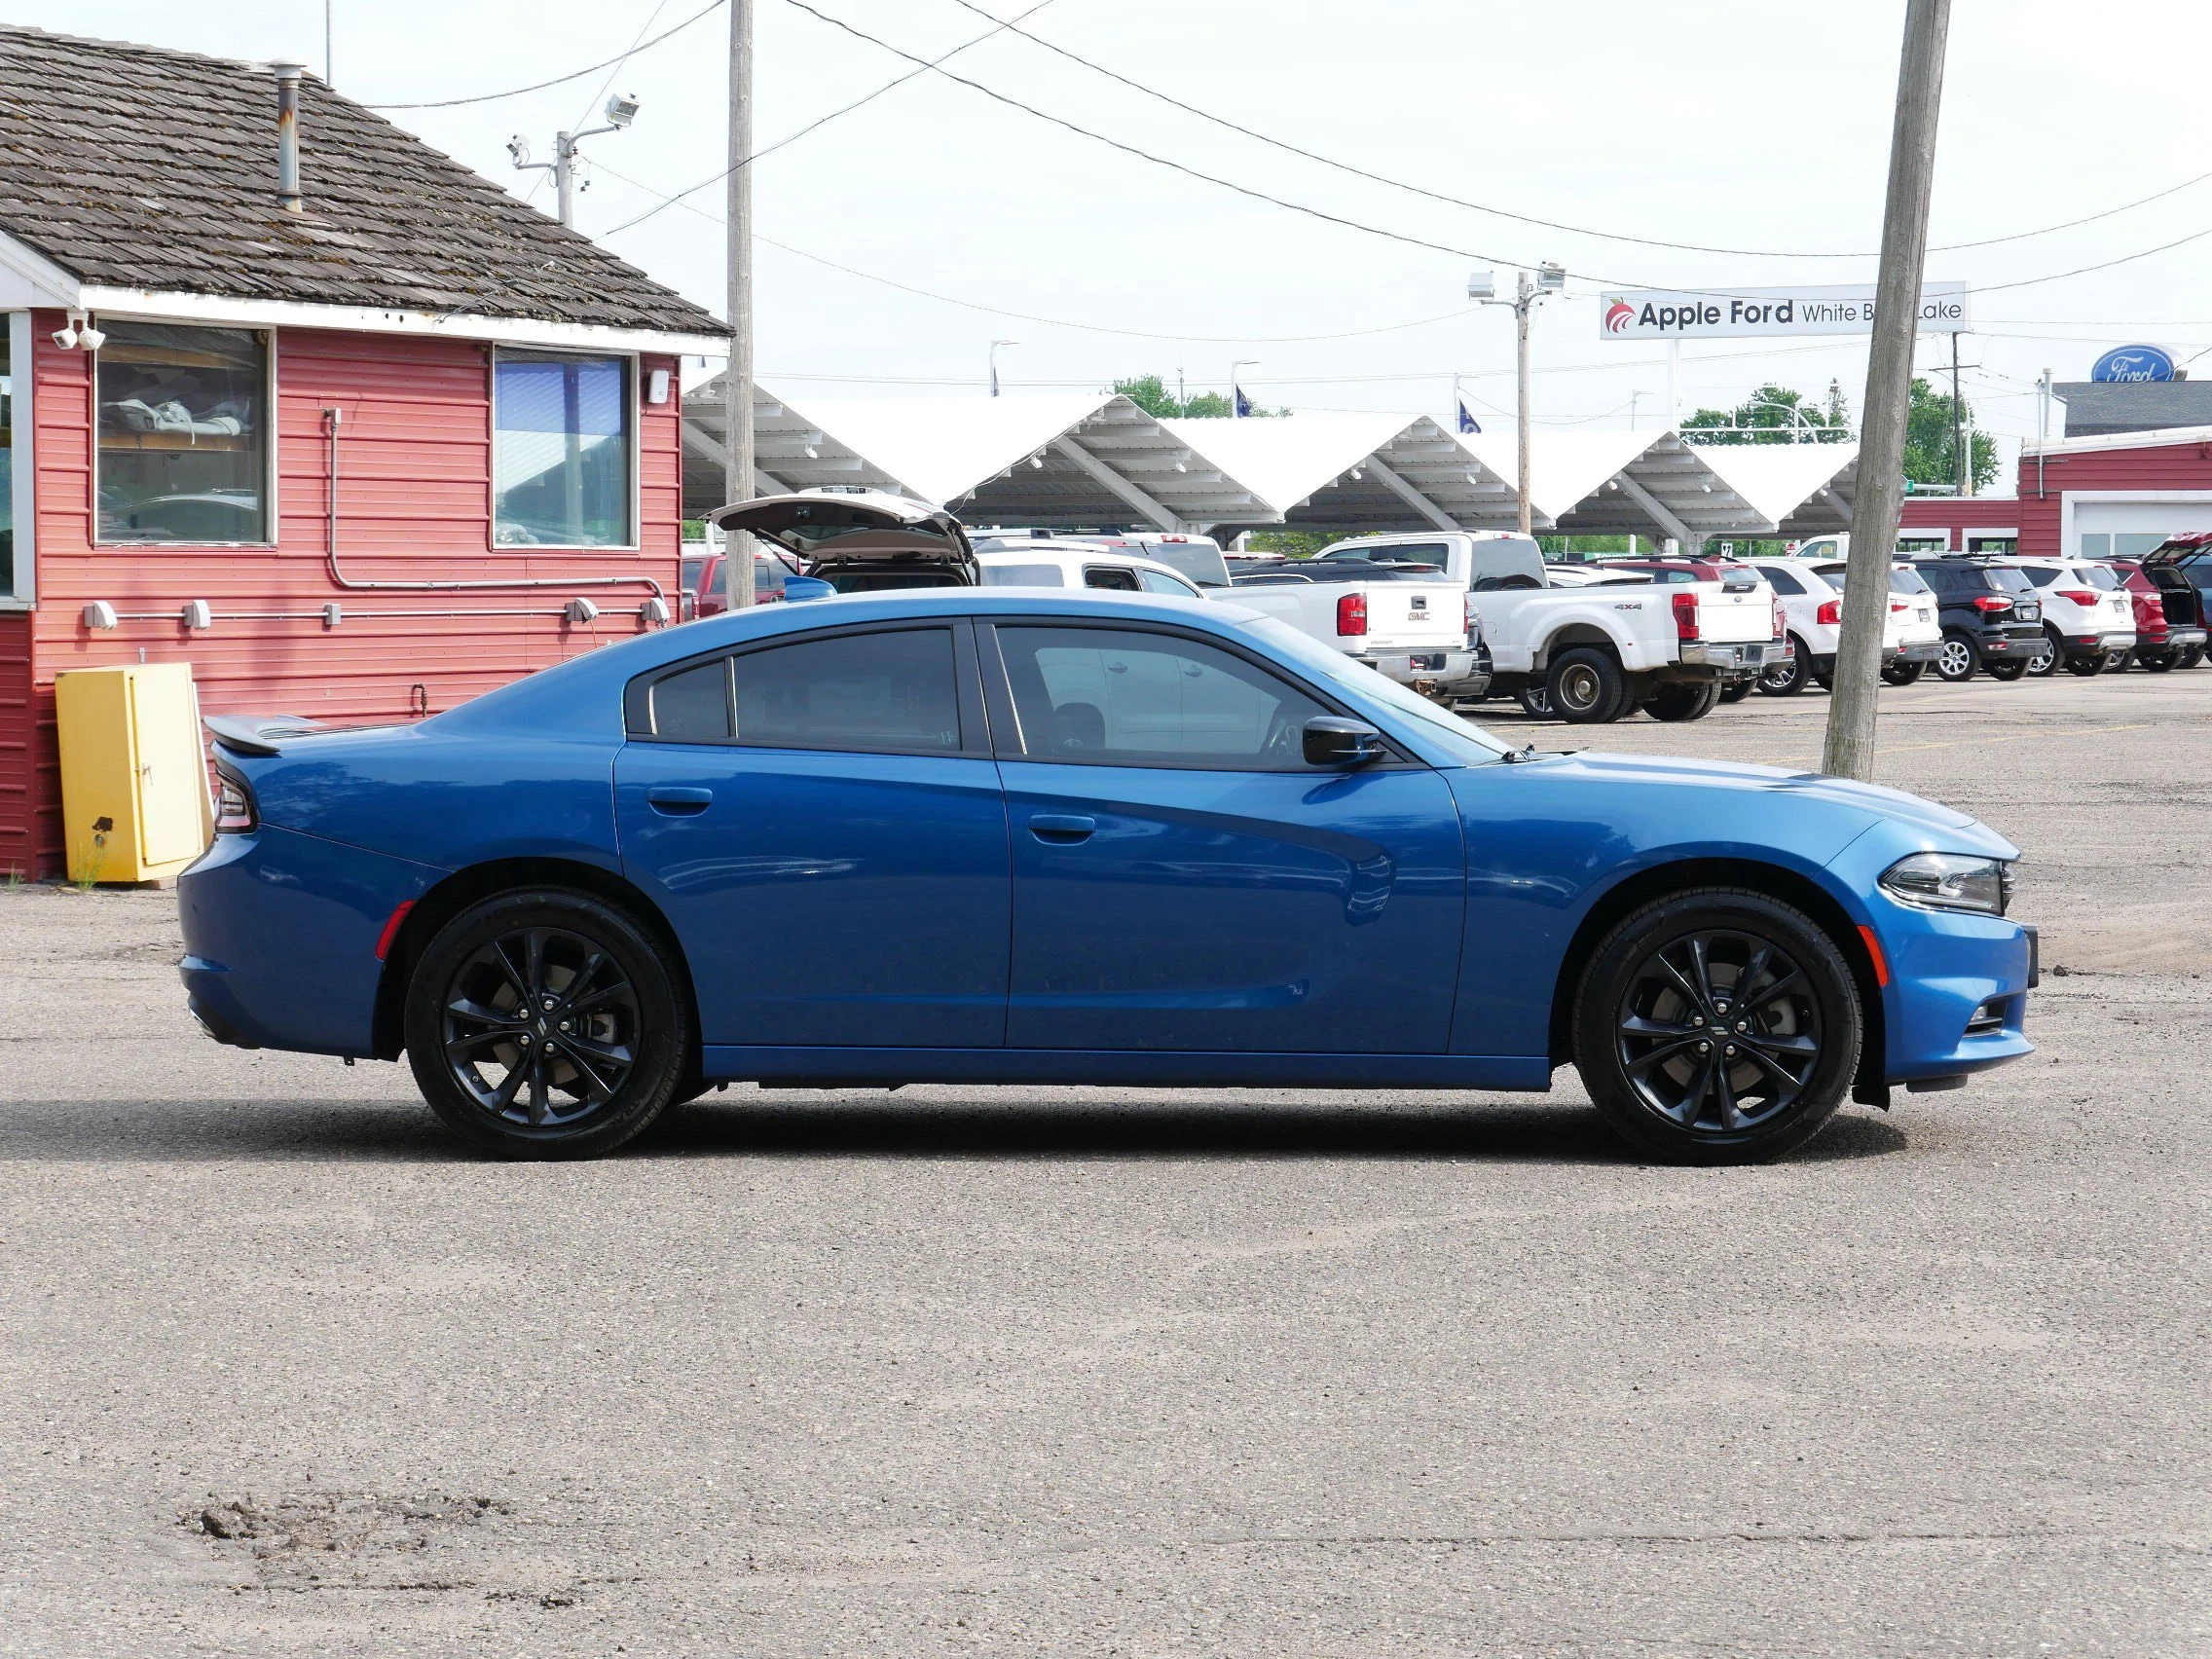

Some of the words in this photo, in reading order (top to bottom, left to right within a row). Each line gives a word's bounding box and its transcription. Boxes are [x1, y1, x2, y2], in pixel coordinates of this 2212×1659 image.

[1638, 301, 1721, 330] Apple
[1730, 299, 1793, 323] Ford
[1802, 304, 1857, 322] White
[1408, 612, 1430, 621] GMC
